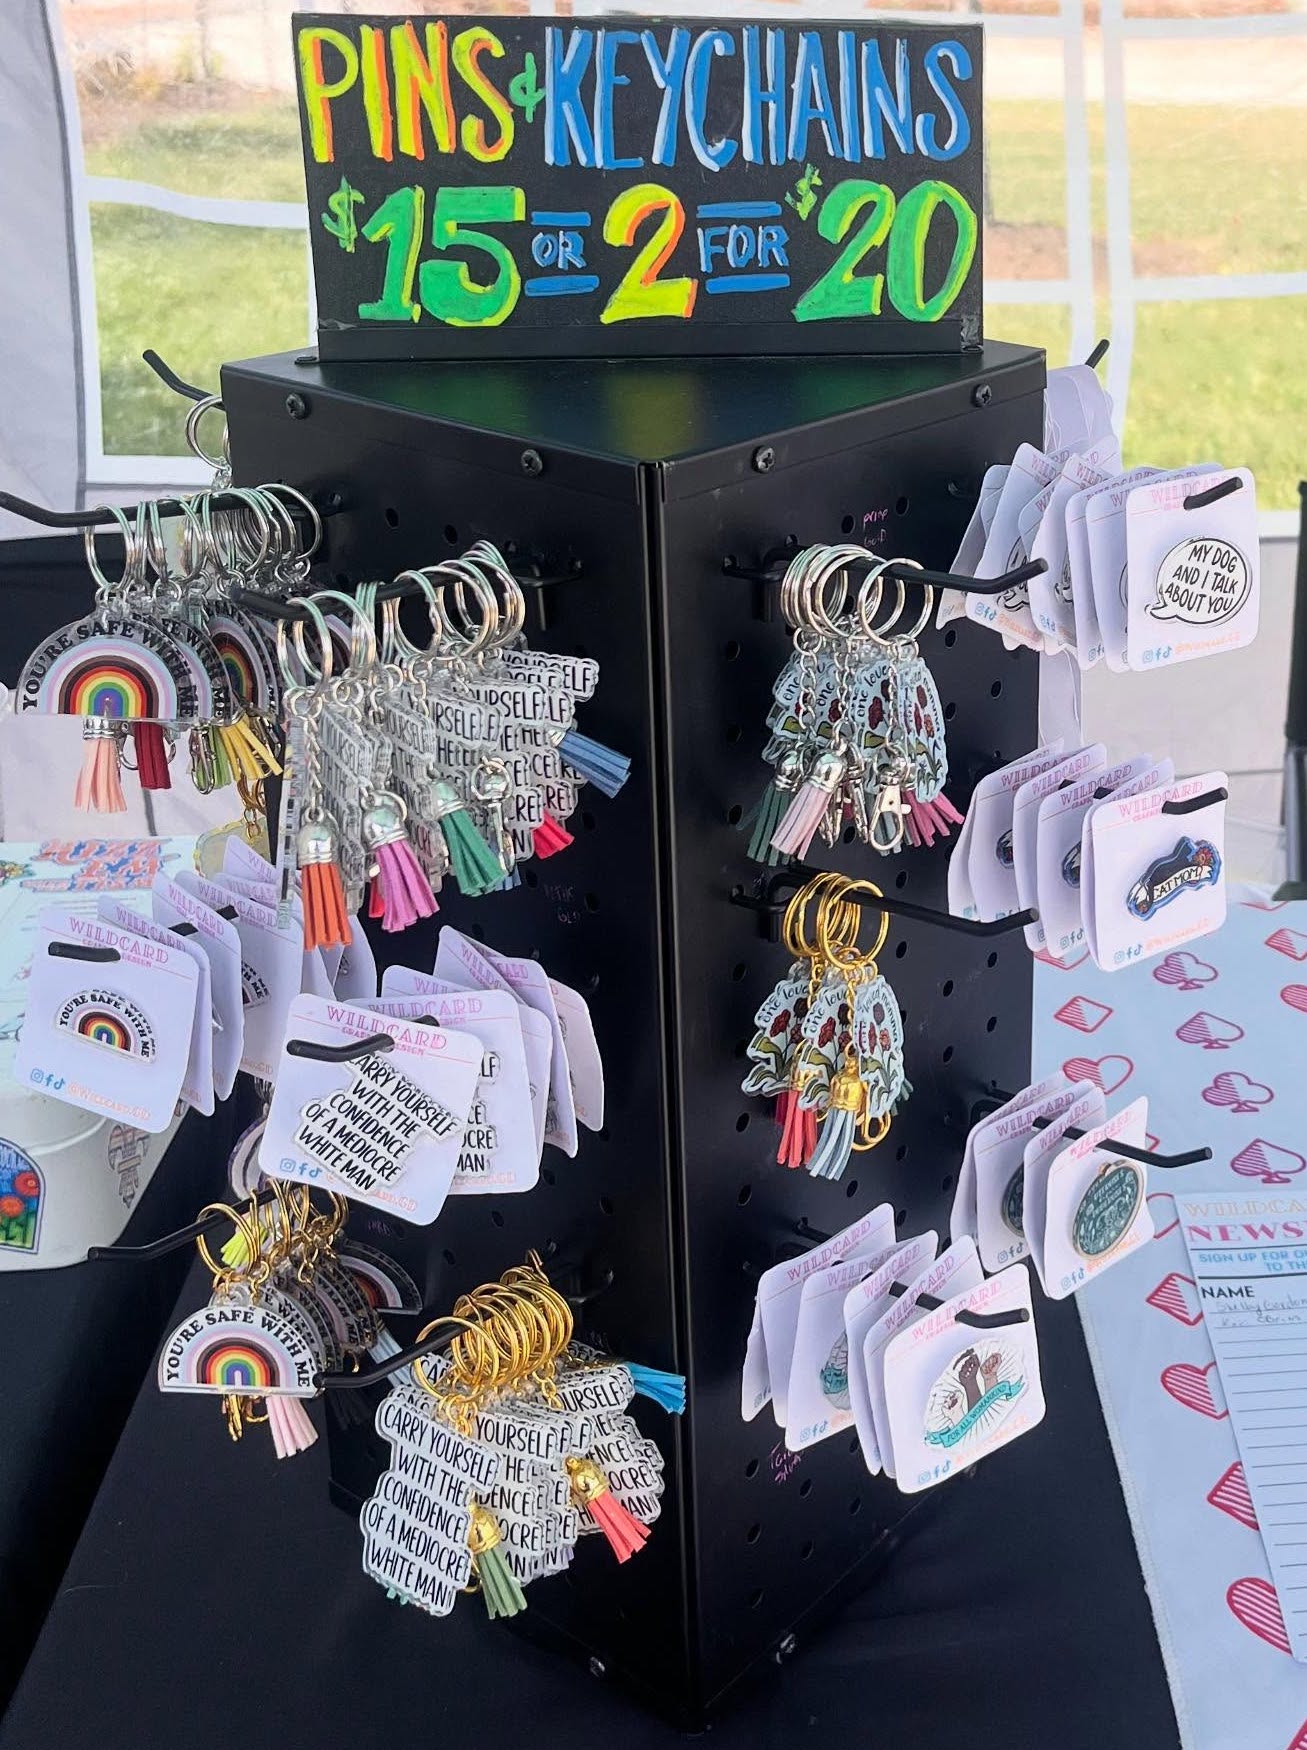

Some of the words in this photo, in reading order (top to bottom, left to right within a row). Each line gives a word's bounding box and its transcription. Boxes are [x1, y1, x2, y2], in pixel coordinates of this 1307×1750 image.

[299, 21, 514, 163] PINS
[543, 24, 972, 171] KEYCHAINS
[322, 175, 526, 327] $15
[531, 226, 588, 269] OR
[601, 182, 698, 324] 2
[698, 224, 790, 273] FOR
[783, 163, 978, 324] $20
[1172, 564, 1200, 585] AND
[1200, 570, 1210, 589] I
[1211, 571, 1239, 595] TALK
[1188, 544, 1213, 563] MY
[1211, 547, 1238, 573] DOG
[1164, 582, 1207, 613] ABOUT
[1207, 597, 1234, 614] YOU
[22, 633, 74, 711] YOU'RE
[76, 620, 136, 640] SAFE
[1118, 780, 1203, 818] WILDCARD
[69, 915, 170, 965] WILDCARD
[59, 994, 89, 1027] YOU'RE
[90, 992, 121, 1010] SAFE
[123, 1007, 148, 1038] WITH
[140, 1040, 150, 1058] ME
[326, 1004, 448, 1051] WILDCARD
[329, 1093, 411, 1160] CONFIDENCE
[352, 1078, 396, 1119] WITH
[390, 1108, 421, 1139] THE
[390, 1079, 458, 1137] YOURSELF
[995, 1092, 1076, 1137] WILDCARD
[299, 1124, 348, 1169] WHITE
[339, 1158, 377, 1191] MAN
[305, 1103, 331, 1123] OF
[321, 1117, 339, 1134] A
[333, 1124, 402, 1182] MEDIOCRE
[786, 1219, 871, 1283] WILDCARD
[863, 1243, 921, 1299] WILDCARD
[1198, 1253, 1234, 1263] SIGN
[1237, 1252, 1257, 1262] UP
[1261, 1250, 1288, 1261] FOR
[1266, 1261, 1283, 1272] TO
[884, 1254, 956, 1332] WILDCARD
[1200, 1285, 1256, 1299] NAME
[166, 1318, 205, 1382] YOU'RE
[204, 1308, 255, 1326] SAFE
[260, 1313, 304, 1358] WITH
[294, 1360, 311, 1388] ME
[475, 1412, 556, 1460] YOURSELF
[946, 1428, 961, 1443] FOR
[959, 1418, 972, 1431] ALL
[970, 1383, 1009, 1420] WOMANKIND
[383, 1403, 430, 1447] CARRY
[429, 1426, 497, 1487] YOURSELF
[398, 1445, 438, 1491] WITH
[439, 1468, 468, 1507] THE
[383, 1475, 465, 1544] CONFIDENCE
[368, 1502, 388, 1532] OF
[385, 1513, 397, 1541] A
[397, 1519, 467, 1582] MEDIOCRE
[371, 1539, 416, 1588] WHITE
[414, 1567, 449, 1608] MAN
